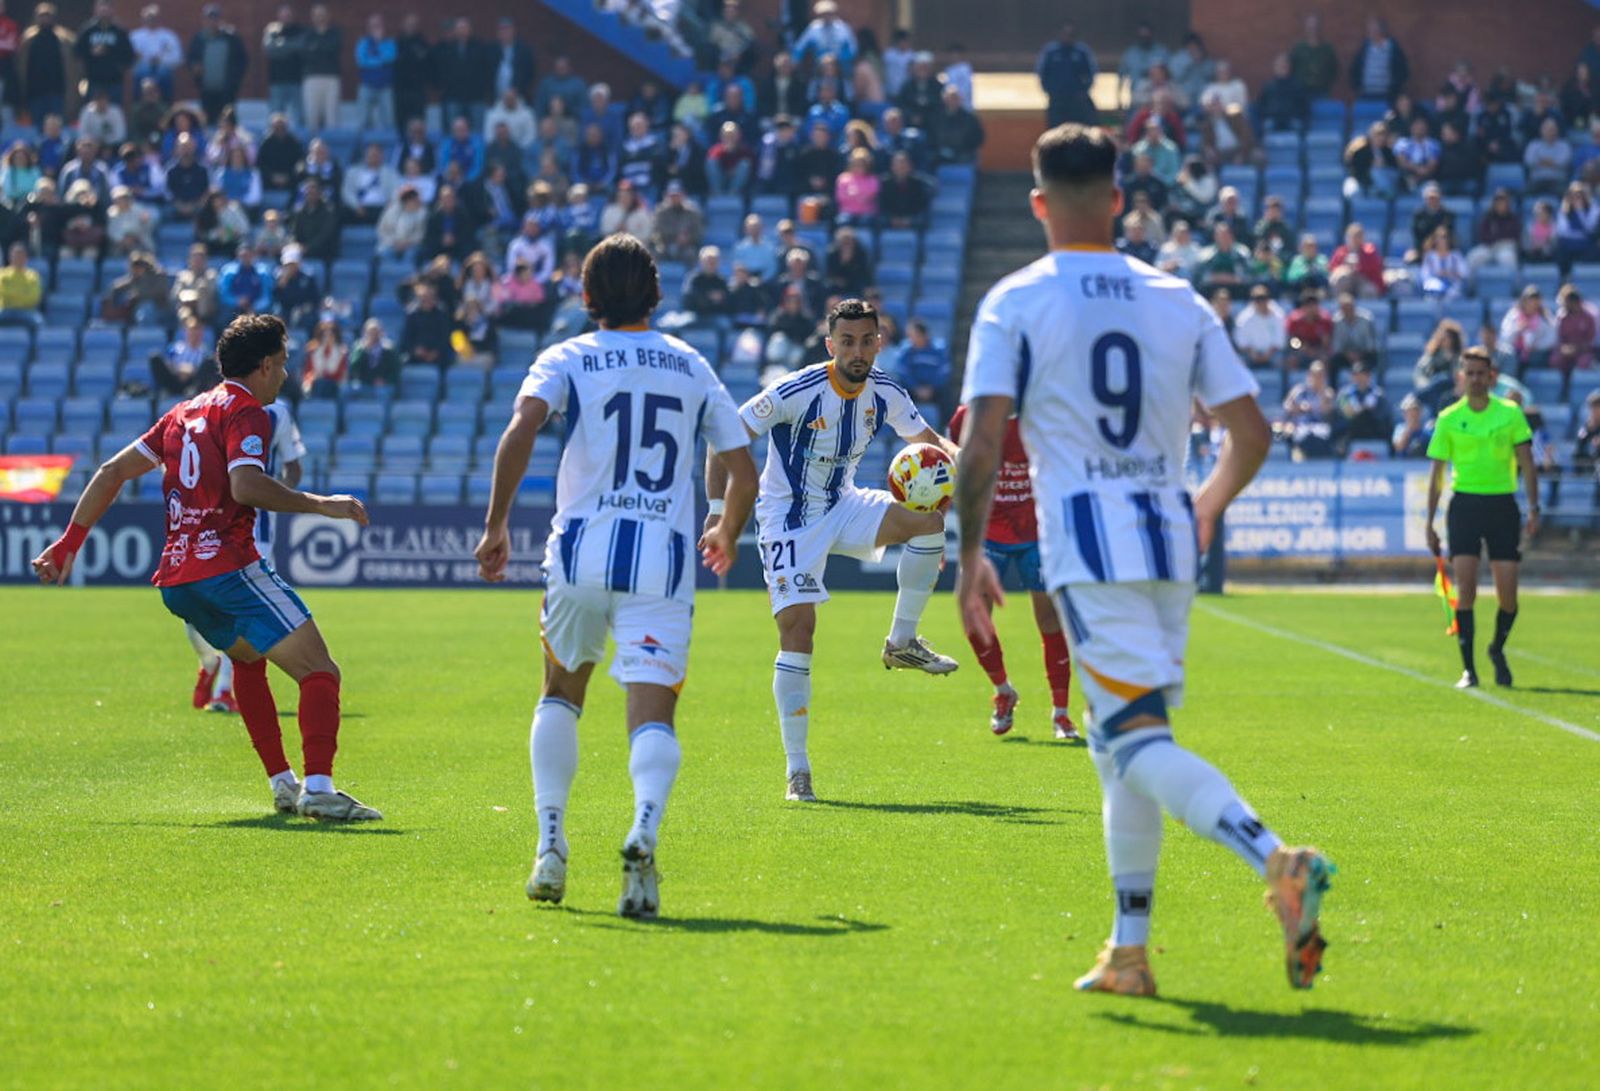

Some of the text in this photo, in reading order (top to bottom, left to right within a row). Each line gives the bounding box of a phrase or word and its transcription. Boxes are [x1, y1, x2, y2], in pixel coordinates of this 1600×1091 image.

[1081, 274, 1137, 301] CAYE
[583, 347, 694, 378] ALEX BERNAL
[1090, 331, 1142, 449] 9
[179, 417, 207, 489] 6
[604, 391, 684, 492] 15
[0, 525, 152, 587] mpo
[771, 539, 796, 571] 21
